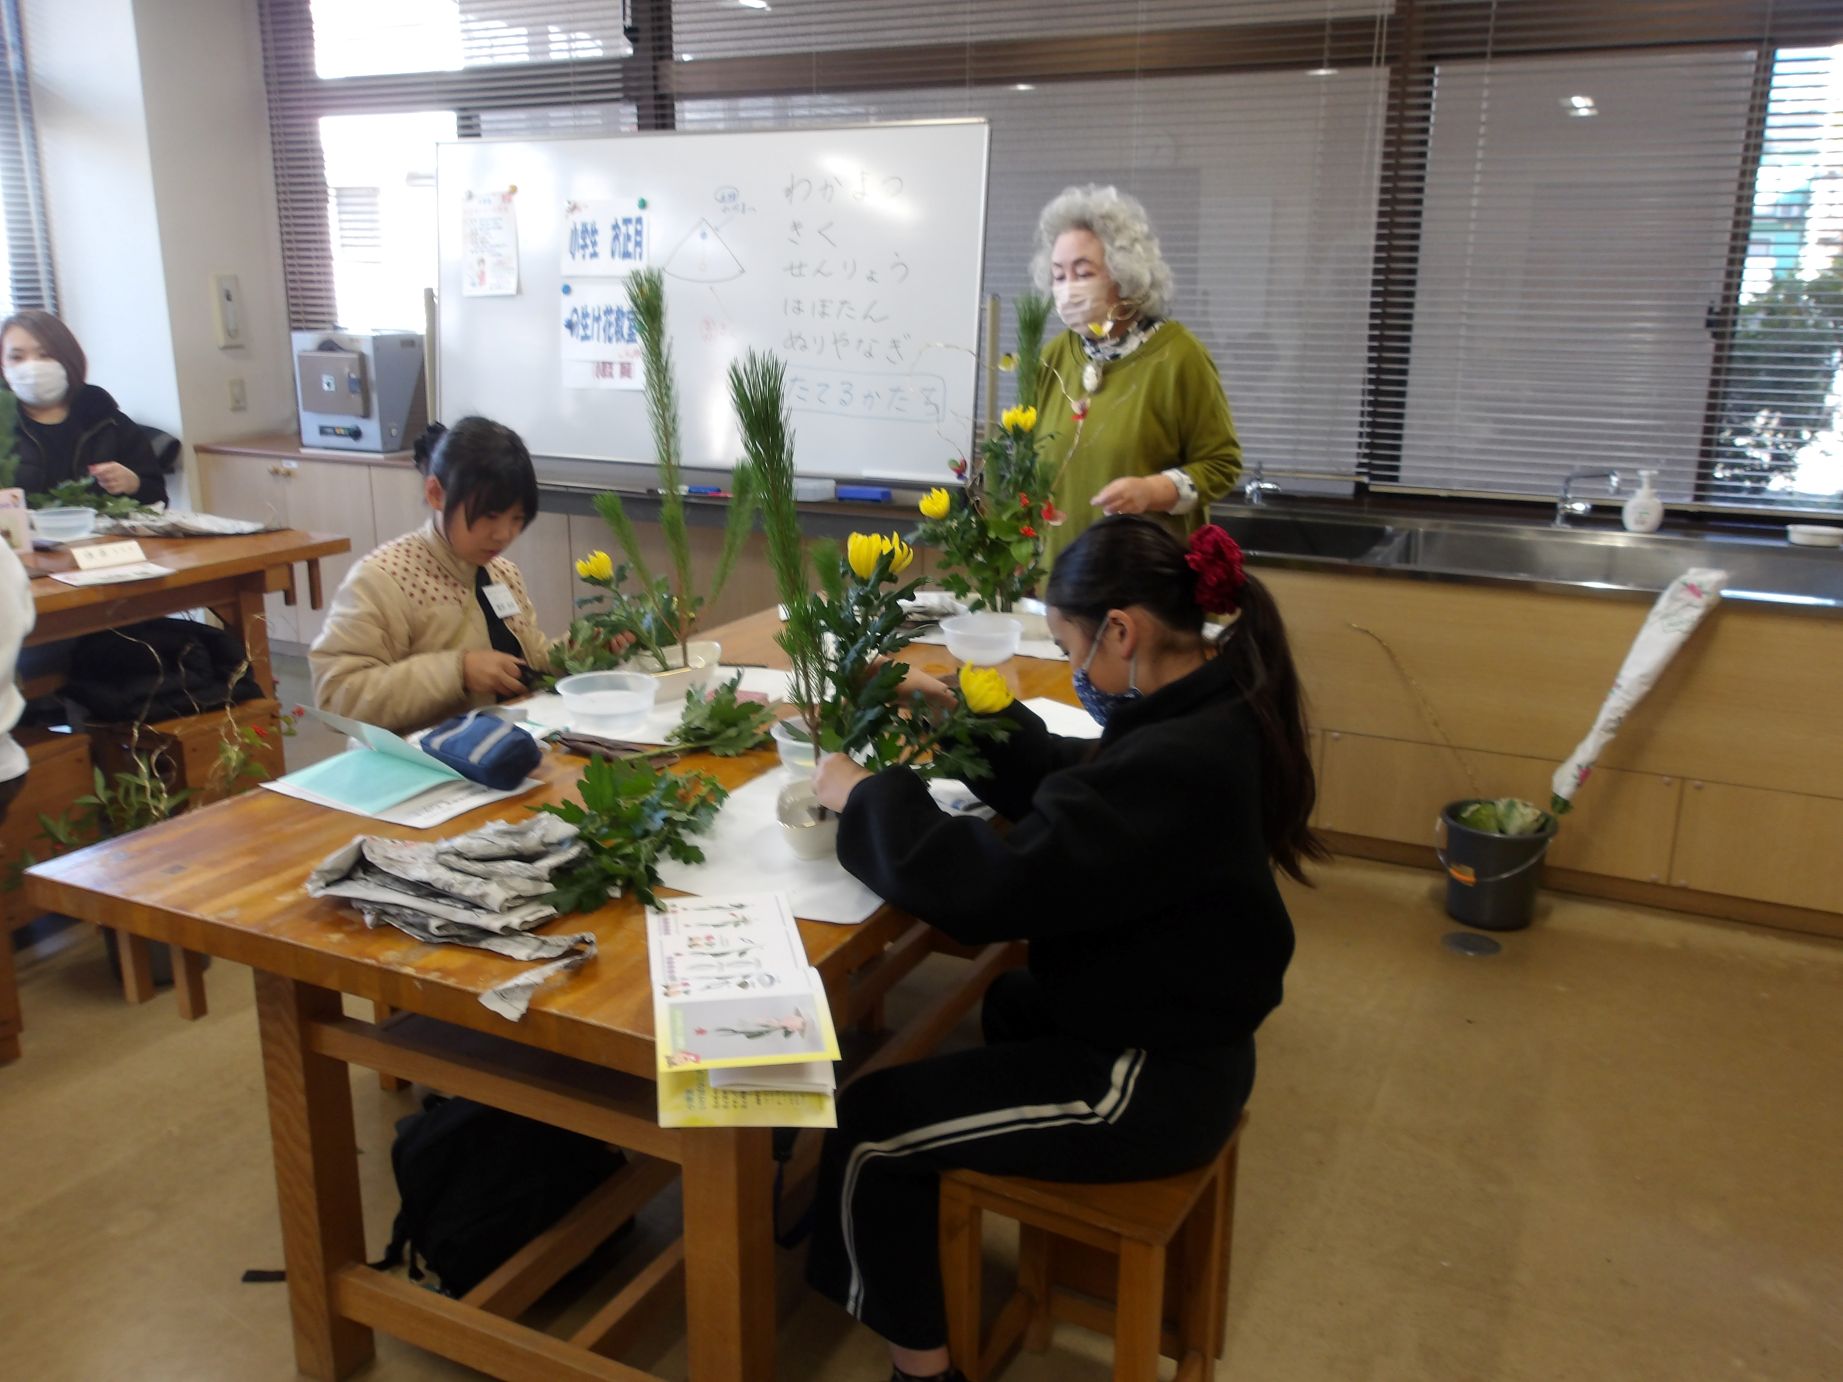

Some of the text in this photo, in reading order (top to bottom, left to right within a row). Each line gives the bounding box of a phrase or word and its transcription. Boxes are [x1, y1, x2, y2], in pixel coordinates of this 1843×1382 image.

[569, 219, 599, 261] 小学生
[787, 220, 838, 248] きく
[782, 252, 910, 284] せんりょう
[782, 329, 912, 366] ぬりやなぎ
